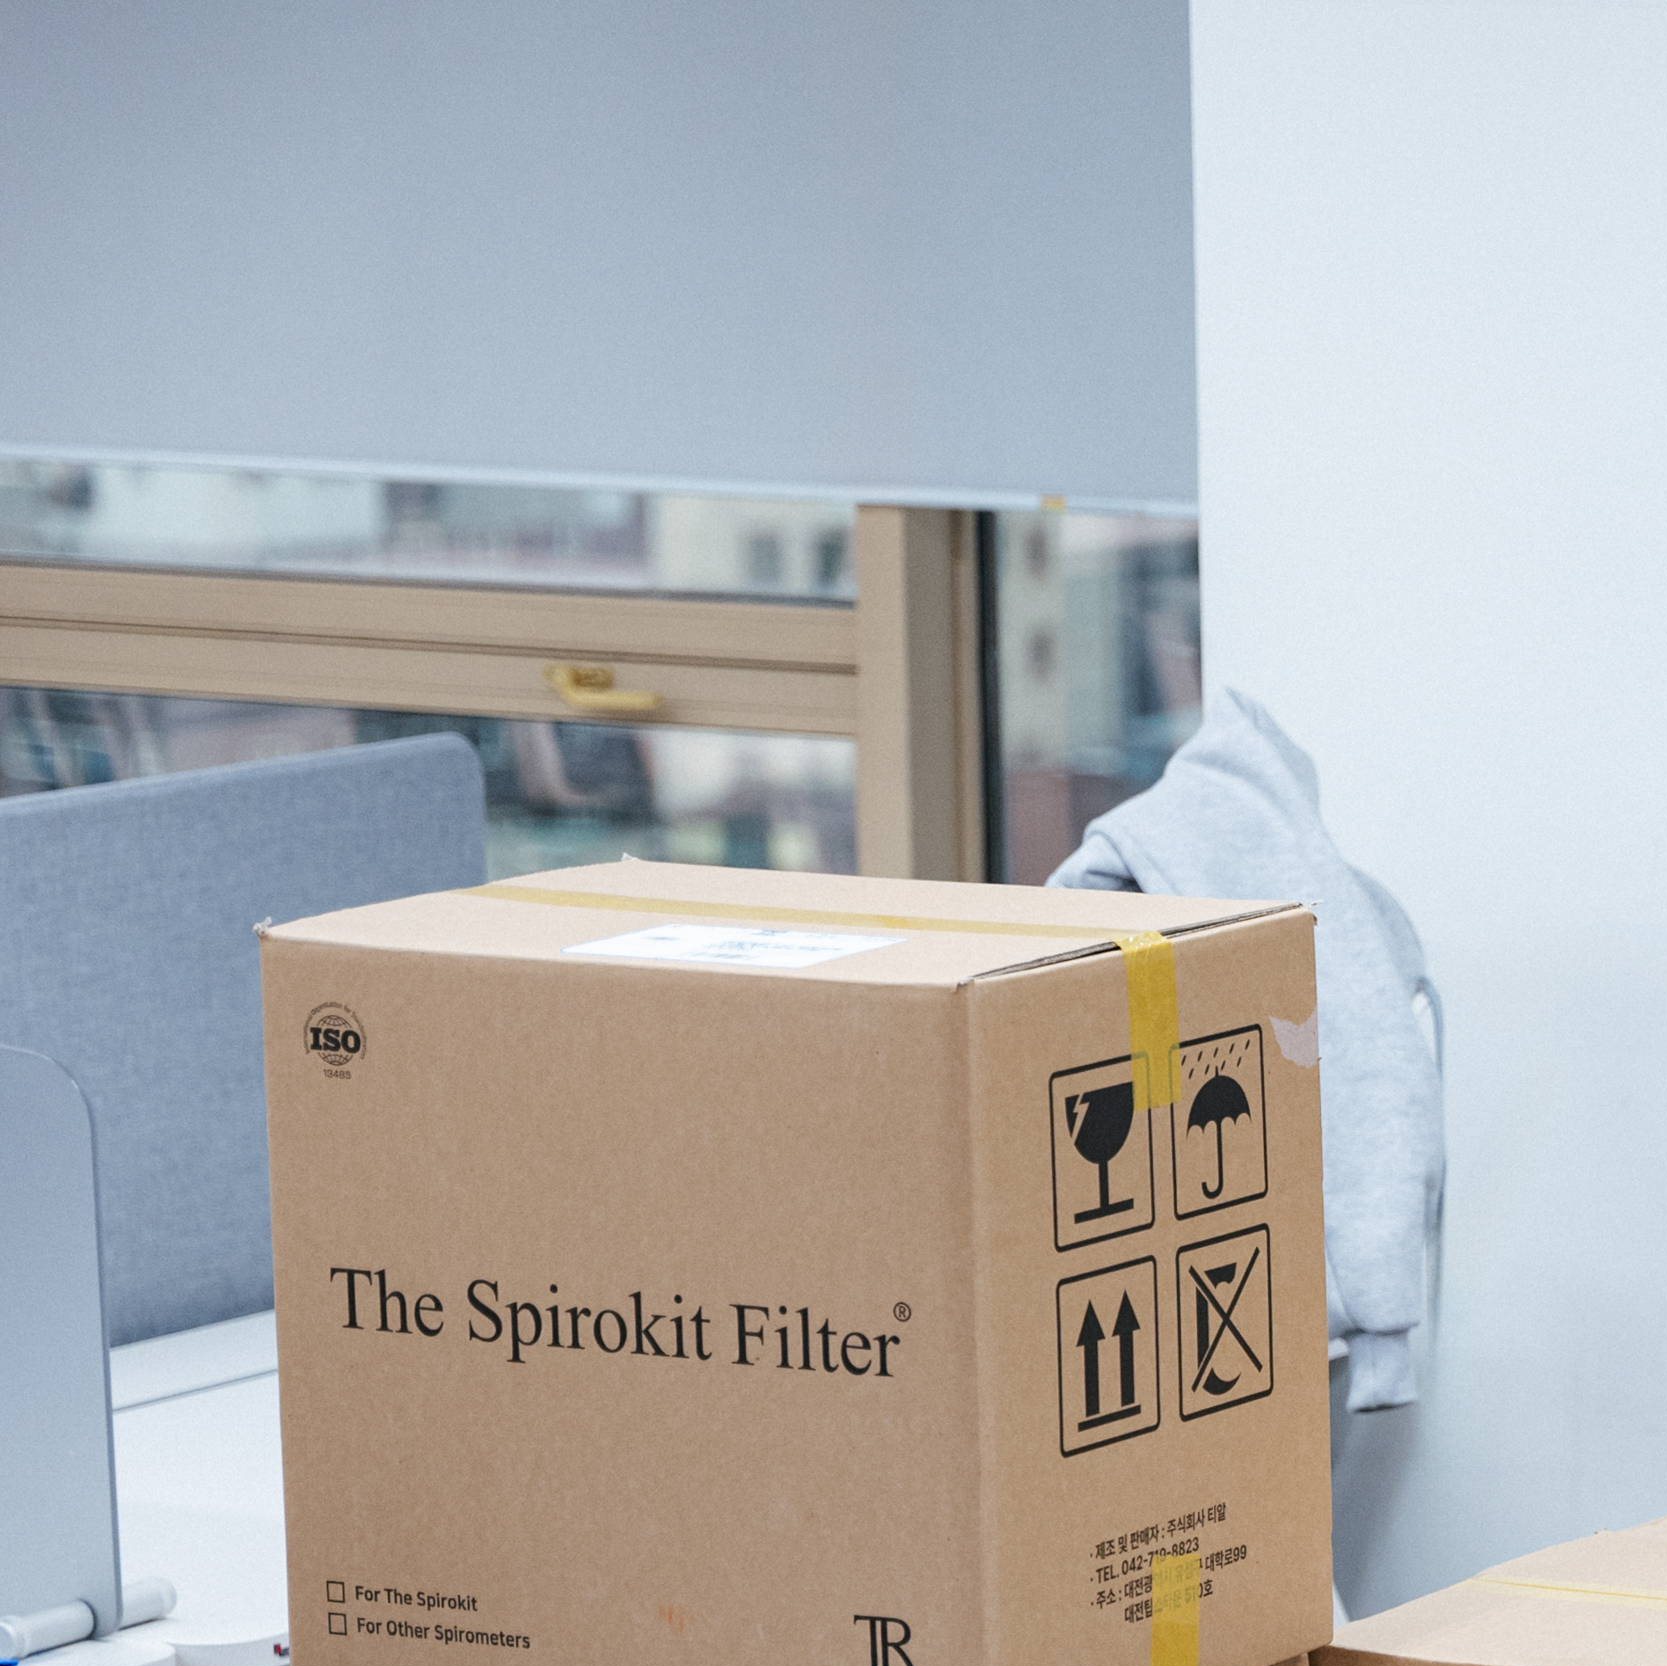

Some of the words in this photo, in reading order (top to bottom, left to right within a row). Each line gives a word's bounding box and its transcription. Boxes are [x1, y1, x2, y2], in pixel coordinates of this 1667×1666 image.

[310, 1027, 361, 1054] ISO
[329, 1266, 444, 1337] The
[467, 1278, 712, 1364] Spirokit
[1095, 1539, 1116, 1560] 제조
[1118, 1534, 1128, 1555] 및
[1130, 1524, 1160, 1551] 판매자
[1167, 1509, 1206, 1537] 주식회사
[1208, 1502, 1226, 1523] 티알
[1096, 1565, 1120, 1584] TEL.
[354, 1584, 381, 1603] For
[383, 1587, 413, 1606] The
[416, 1590, 478, 1612] Spirokit
[356, 1616, 383, 1635] For
[385, 1619, 430, 1639] Other
[433, 1624, 531, 1649] Spirometers
